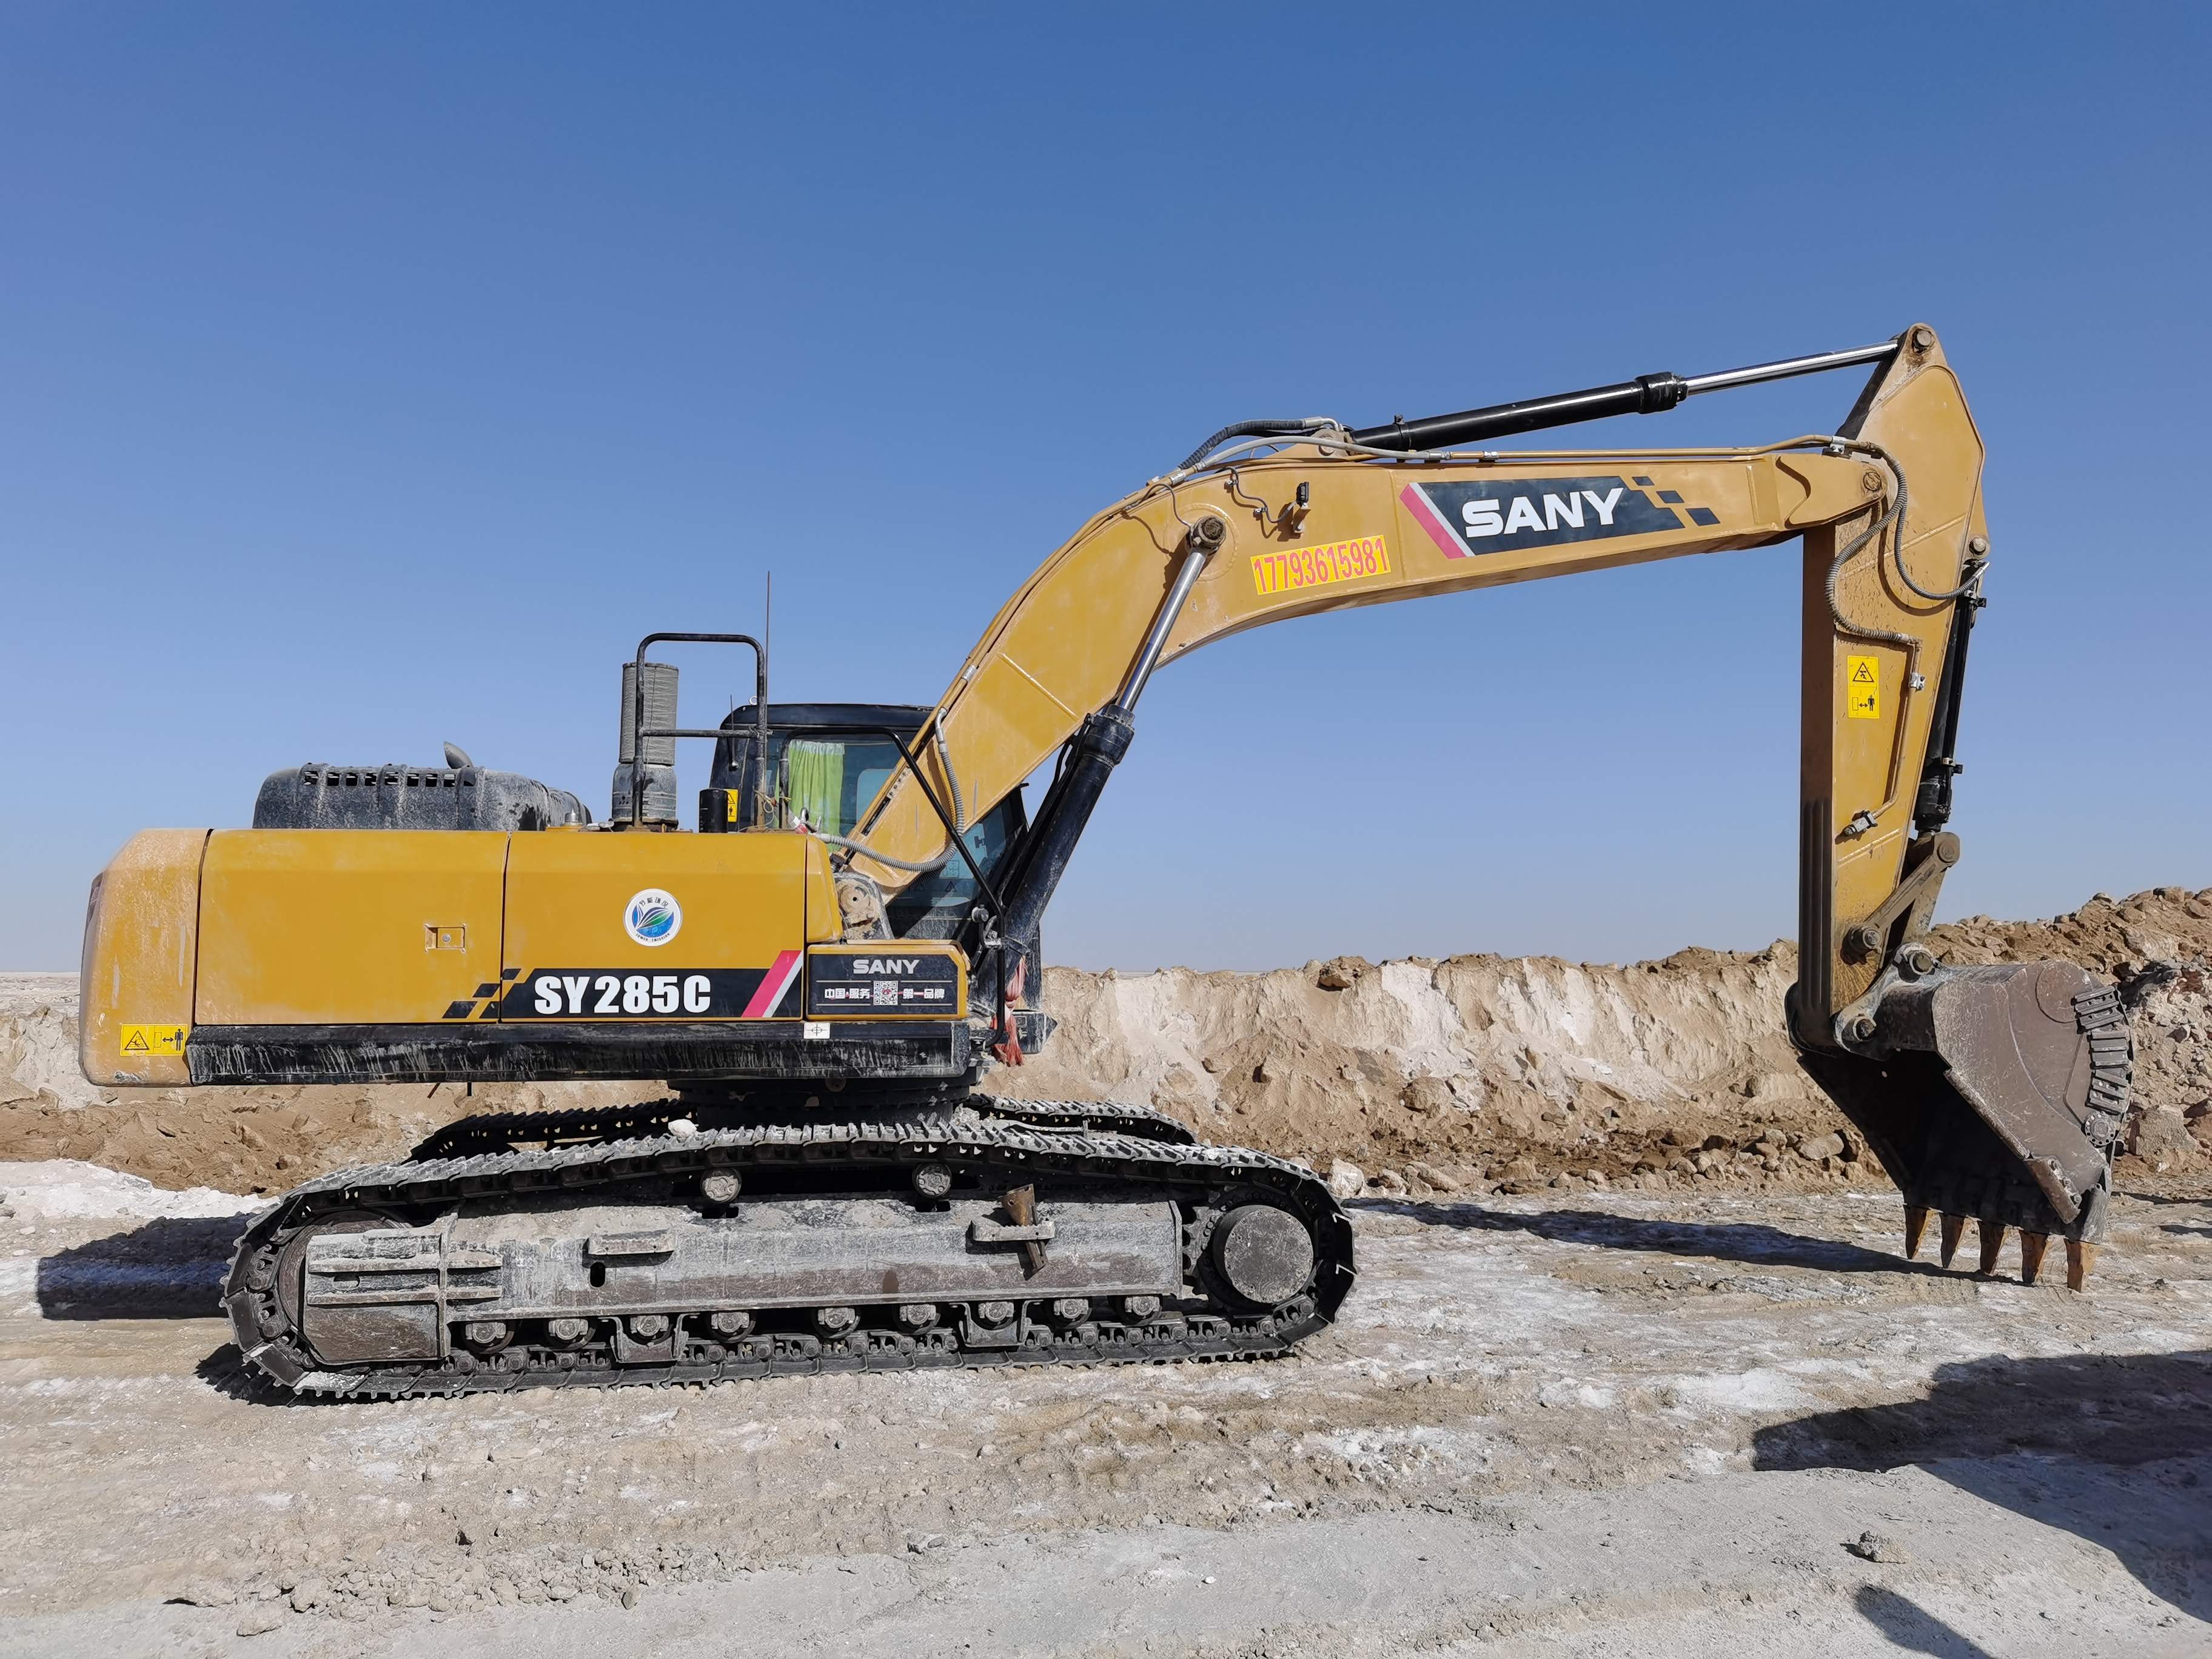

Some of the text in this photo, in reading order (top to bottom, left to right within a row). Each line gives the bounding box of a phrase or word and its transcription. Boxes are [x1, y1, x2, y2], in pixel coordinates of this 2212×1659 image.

[1462, 487, 1624, 538] SANY
[1254, 538, 1388, 592] 17793615981
[853, 959, 920, 974] SANY
[534, 975, 711, 1014] SY285C
[903, 988, 945, 999] 第一品牌
